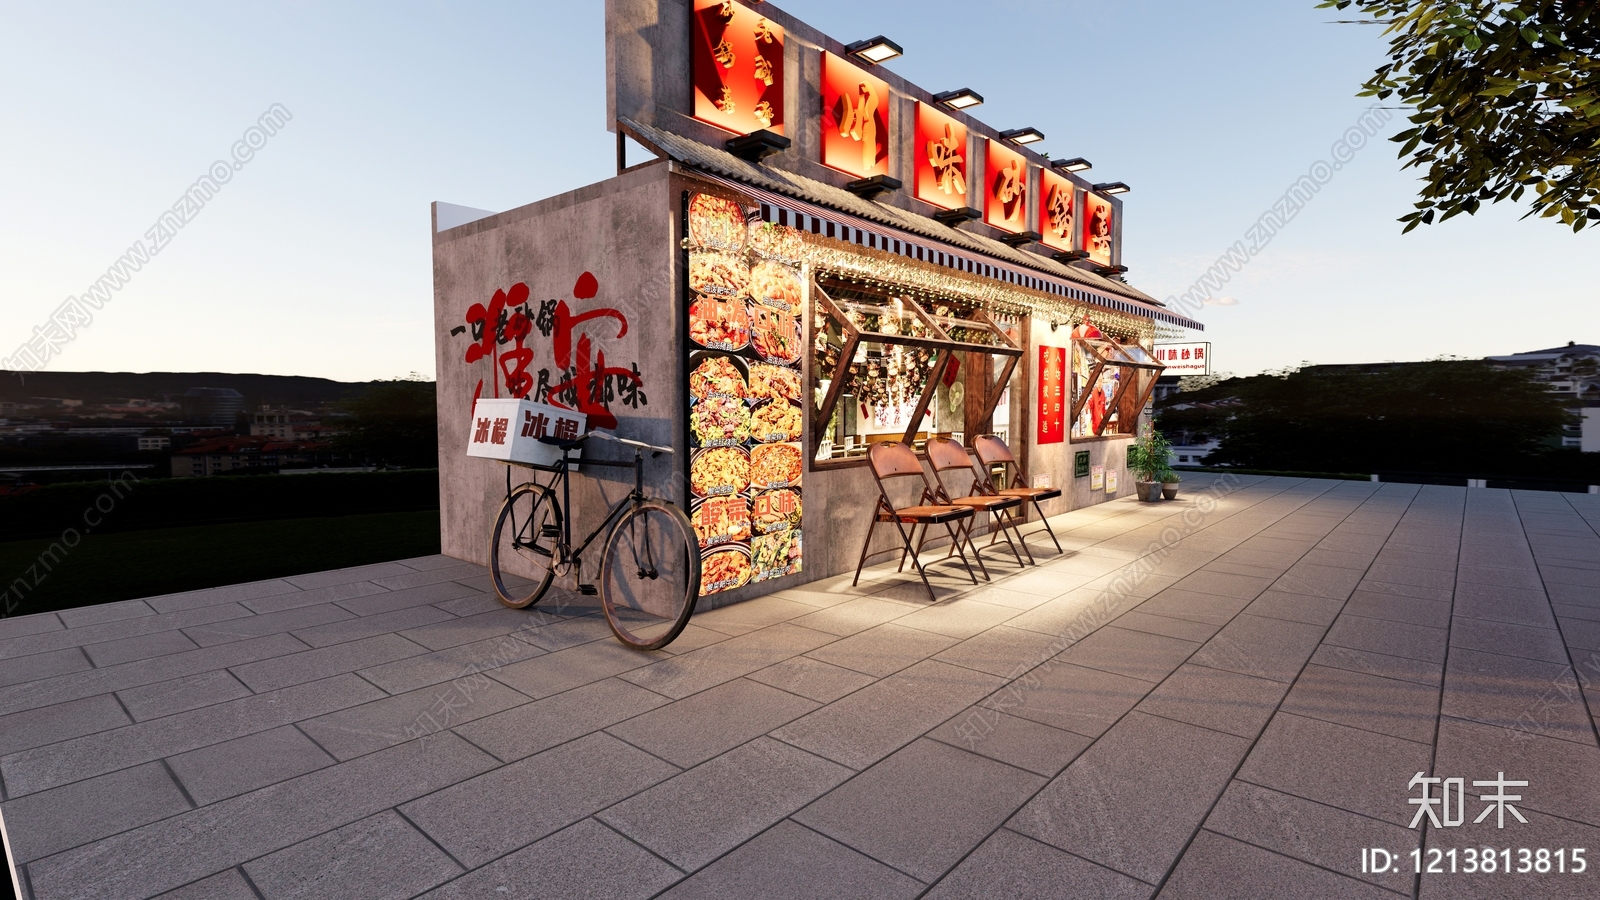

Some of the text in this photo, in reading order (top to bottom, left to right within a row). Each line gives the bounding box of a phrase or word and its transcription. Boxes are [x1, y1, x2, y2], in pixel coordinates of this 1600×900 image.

[697, 294, 795, 339] 油泼口味
[1156, 348, 1204, 361] 川味砂锅
[474, 417, 509, 445] 冰棍
[521, 410, 579, 441] 冰棍
[701, 491, 795, 525] 酸菜口味
